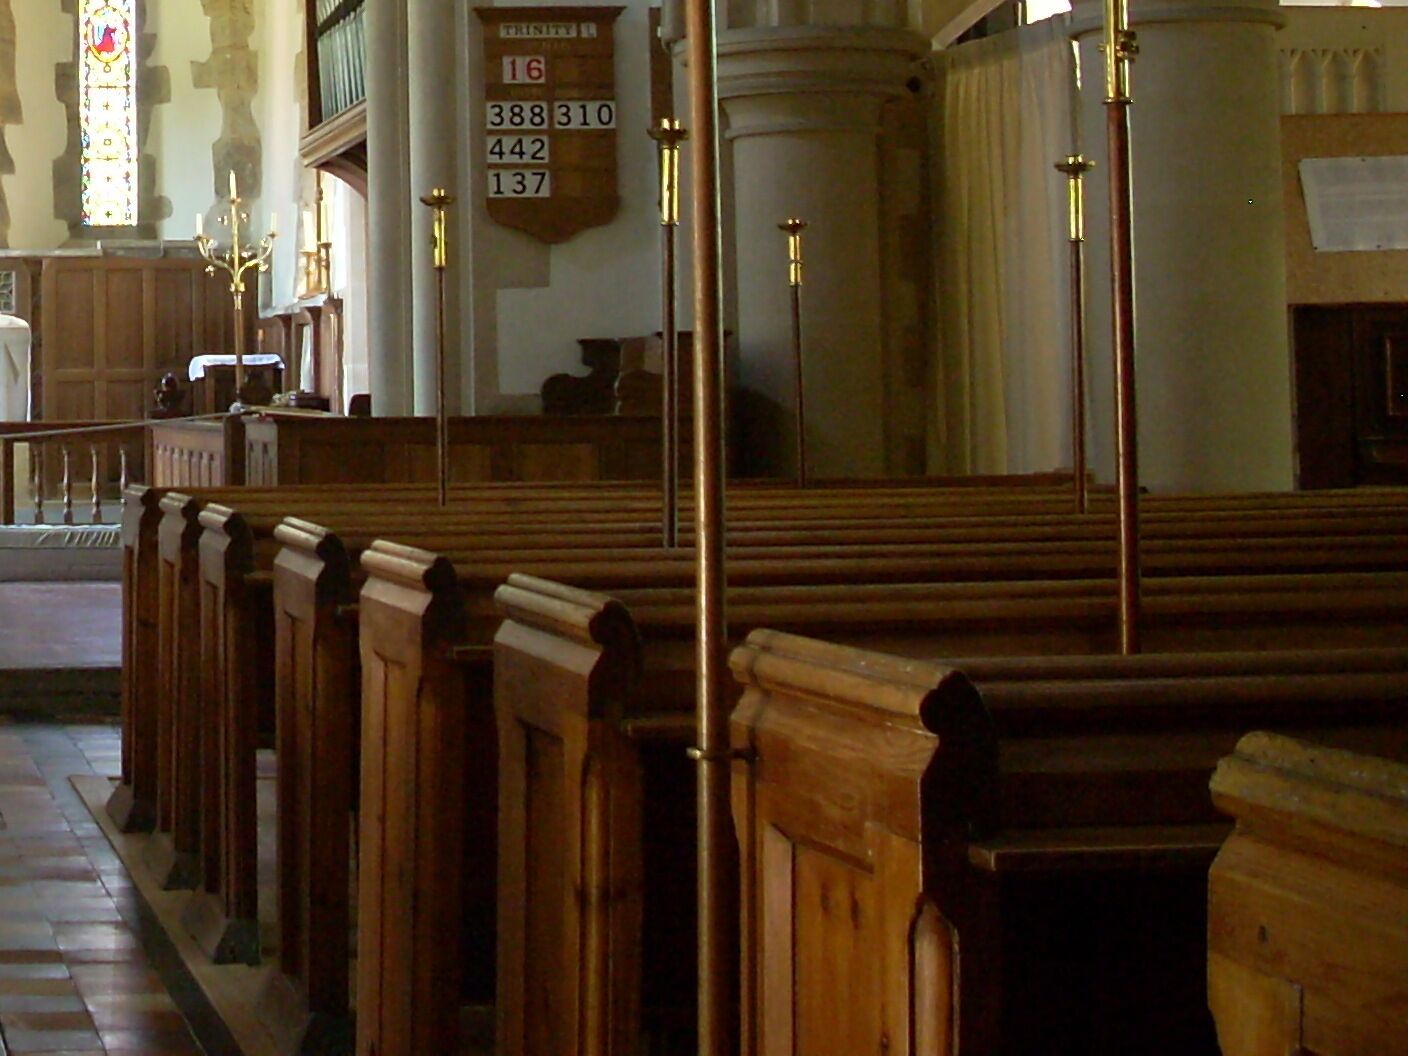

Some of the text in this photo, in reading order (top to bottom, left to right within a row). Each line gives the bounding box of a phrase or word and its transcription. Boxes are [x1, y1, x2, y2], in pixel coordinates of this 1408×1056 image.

[502, 24, 574, 36] TRINITY
[509, 58, 544, 81] 16
[489, 103, 613, 126] 388 310
[489, 138, 546, 161] 442
[491, 171, 547, 195] 137
